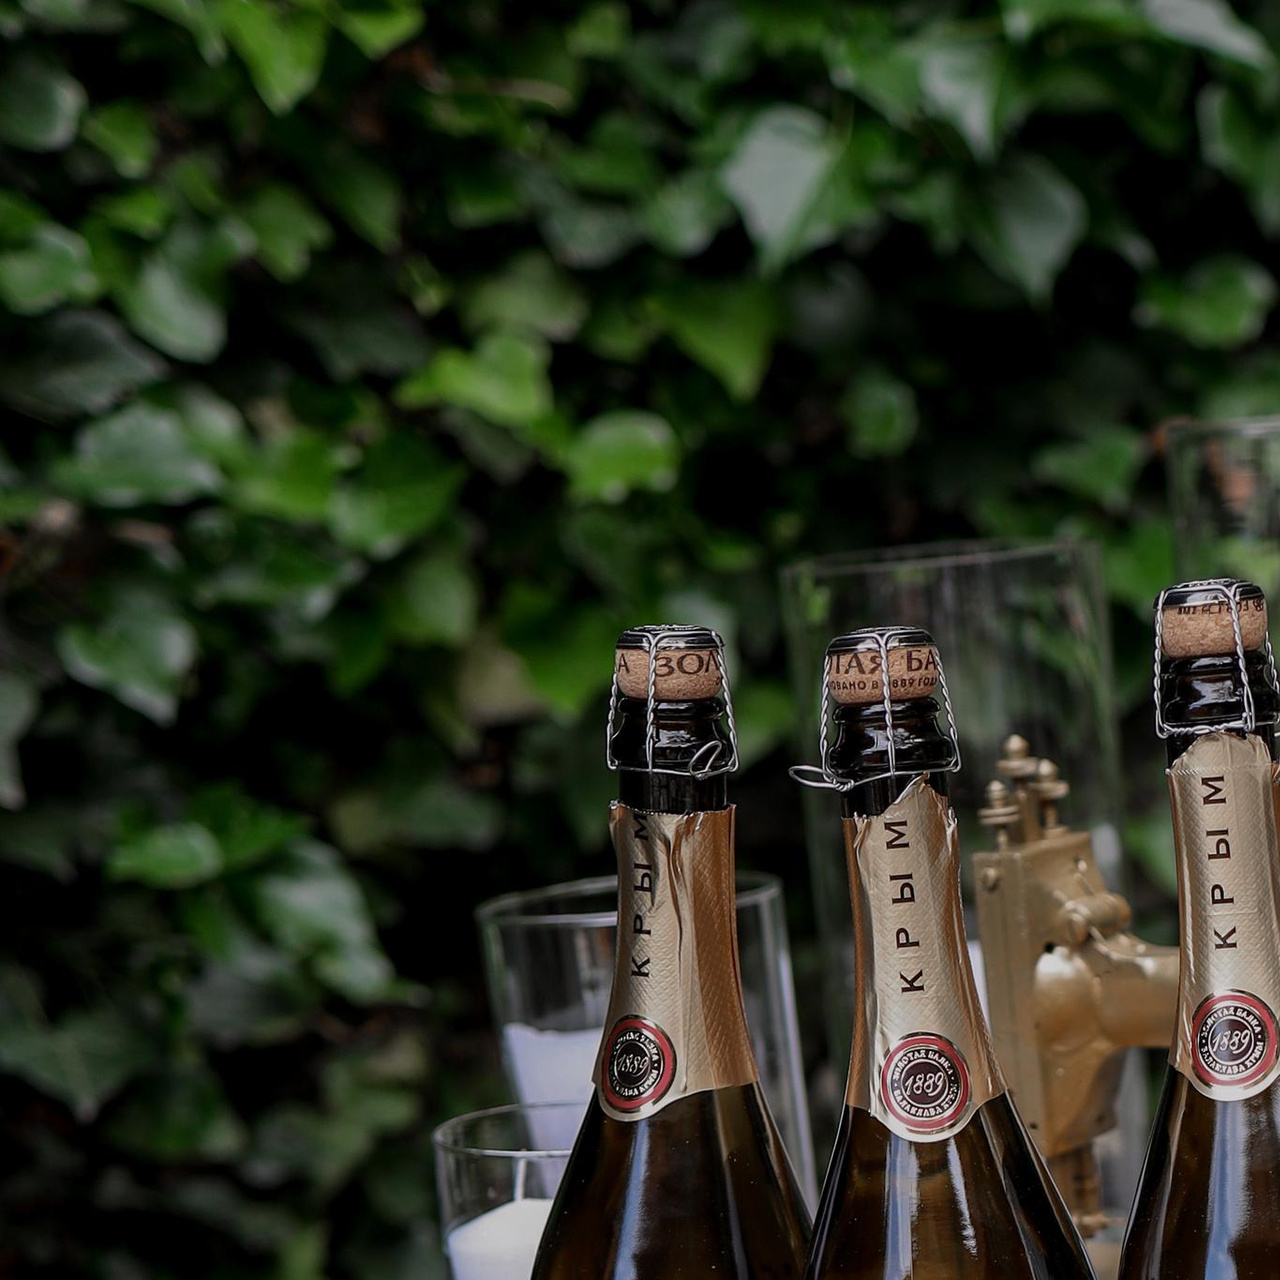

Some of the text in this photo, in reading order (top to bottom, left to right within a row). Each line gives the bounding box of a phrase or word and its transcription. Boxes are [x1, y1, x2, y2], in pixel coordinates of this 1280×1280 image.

[830, 681, 866, 690] ОВАНО
[892, 677, 913, 688] 889
[1202, 776, 1238, 950] КРЫМ
[631, 814, 653, 978] КРЫМ
[885, 820, 925, 994] КРЫМ
[1212, 1030, 1250, 1054] 1889
[618, 1053, 650, 1077] 1889
[905, 1072, 943, 1096] 1889
